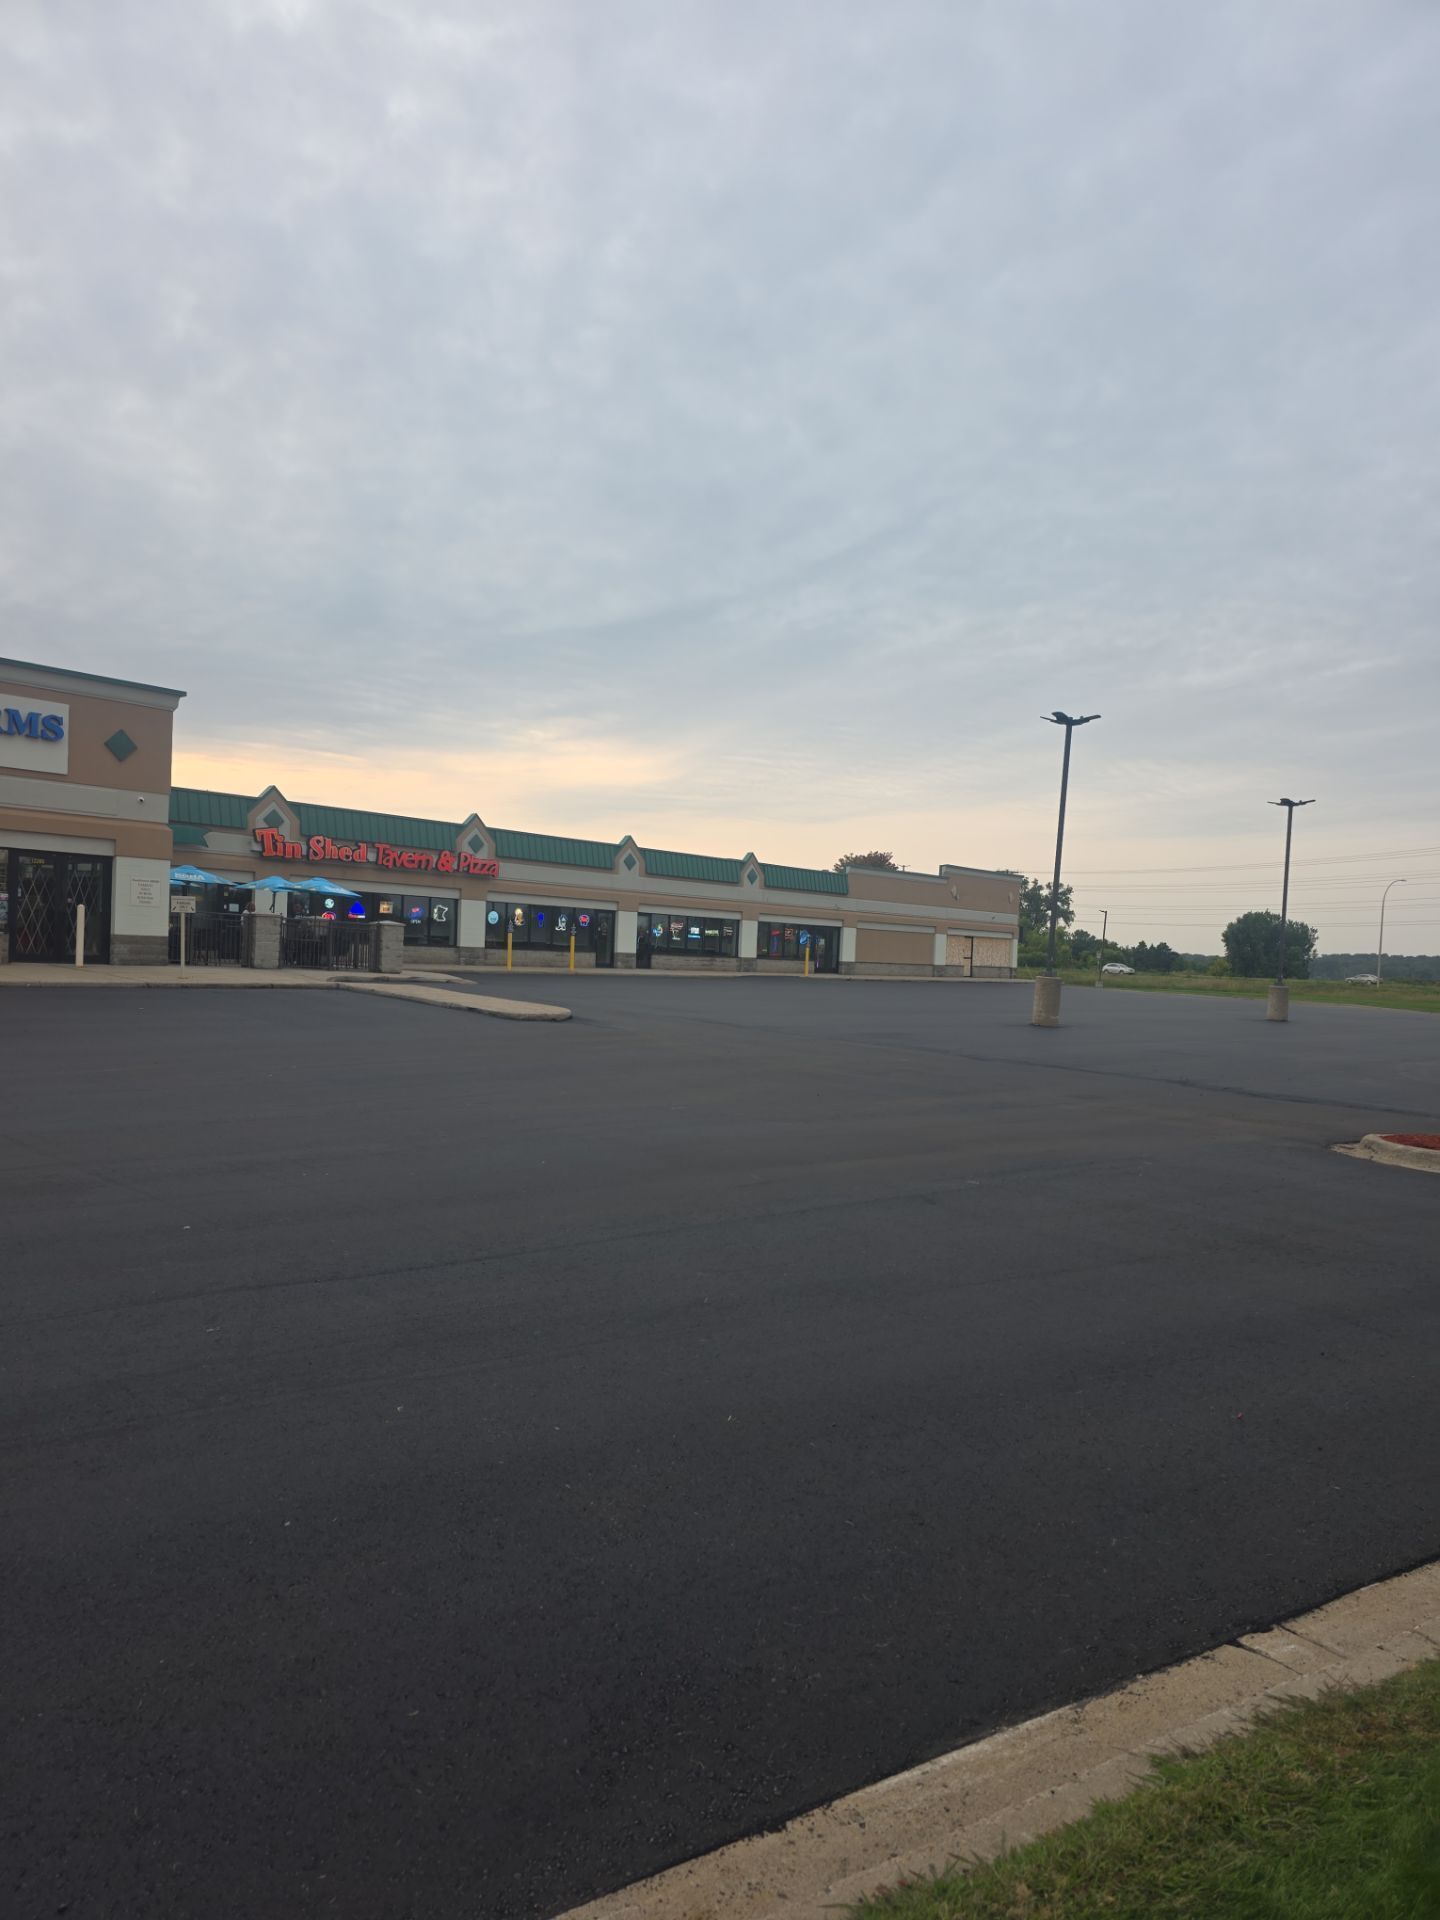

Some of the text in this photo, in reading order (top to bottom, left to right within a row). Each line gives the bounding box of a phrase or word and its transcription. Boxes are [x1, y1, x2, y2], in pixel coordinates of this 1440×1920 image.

[0, 708, 64, 741] MS
[255, 827, 500, 877] Tin Shed Tavern & Pizza
